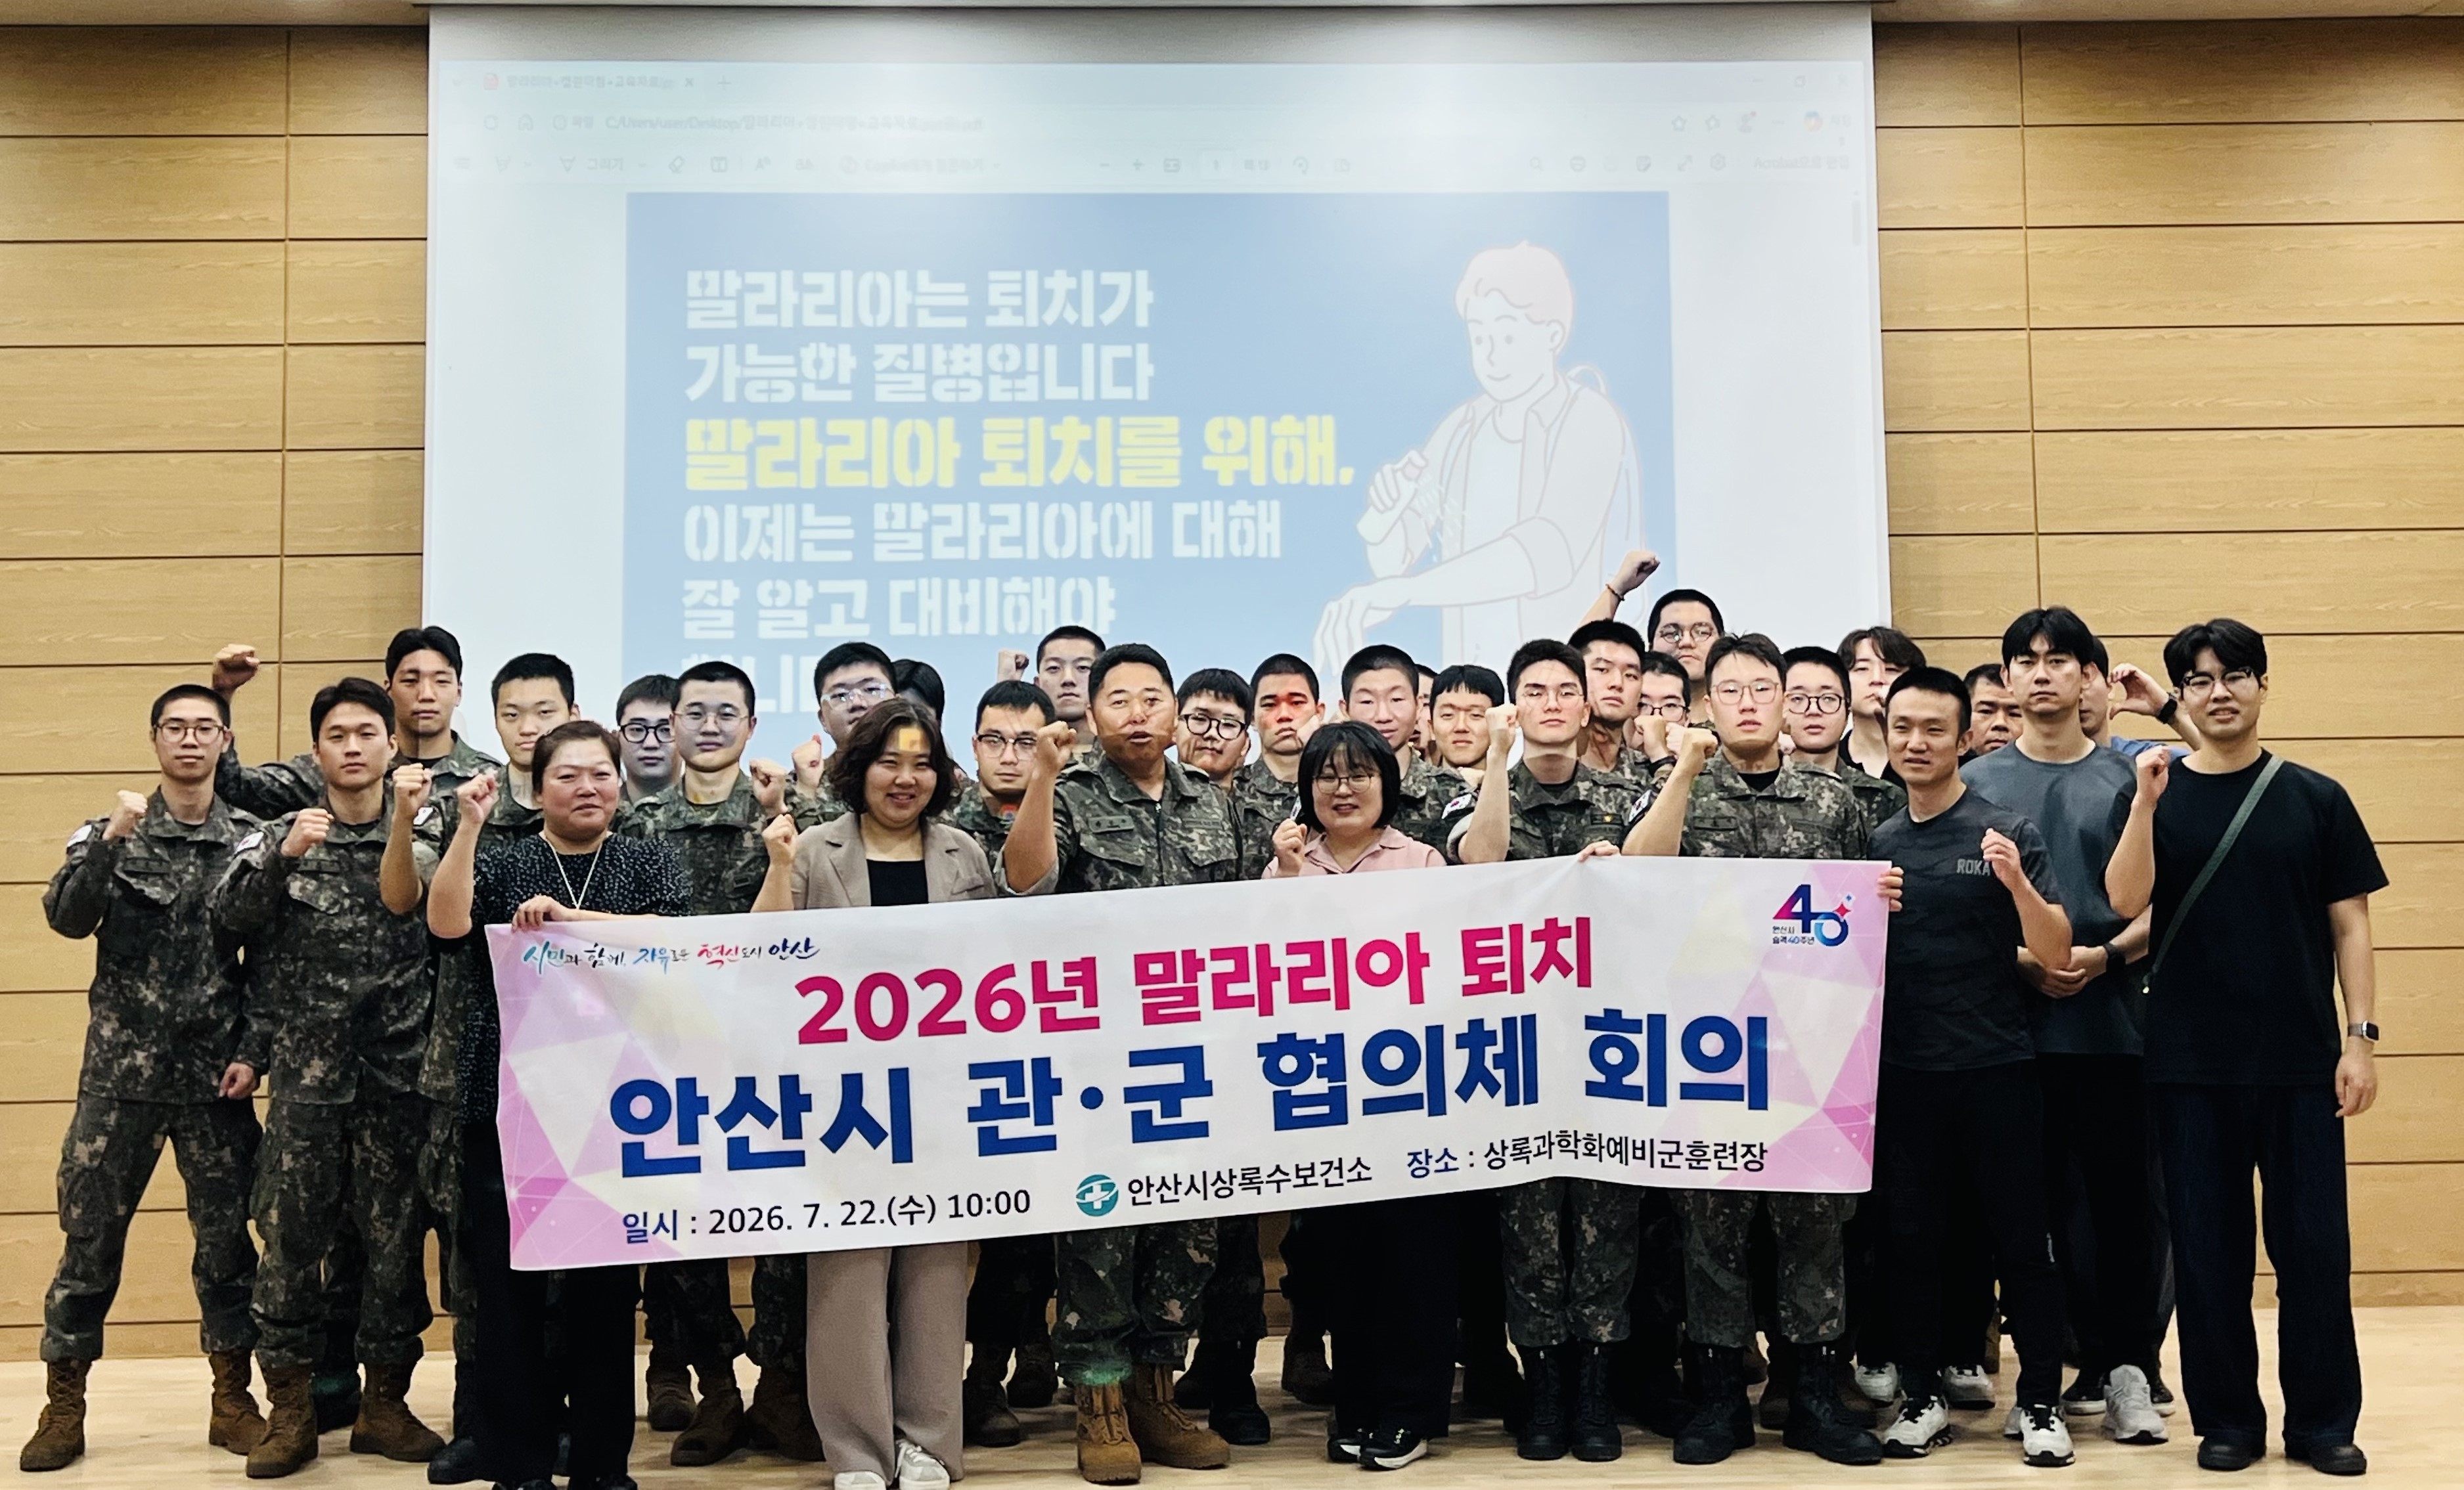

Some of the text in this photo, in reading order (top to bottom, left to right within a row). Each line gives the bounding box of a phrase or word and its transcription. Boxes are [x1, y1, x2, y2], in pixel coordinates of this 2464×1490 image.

[686, 269, 1154, 328] 말라리아는 퇴치가
[684, 341, 1154, 403] 가능한 질병입니다
[685, 414, 1355, 491] 말라리아 퇴치를 위해,
[683, 499, 1282, 564] 이제는 말라리아에 대해
[681, 575, 1117, 640] 잘 알고 대비해야
[1957, 858, 1990, 876] ROKA
[524, 941, 581, 975] 시민과
[633, 947, 690, 974] 자유로운
[697, 944, 761, 970] 혁신도시
[768, 937, 821, 960] 안산
[795, 917, 1592, 1044] 2026년 말라리아 퇴치
[610, 1009, 1768, 1179] 안산시 관·군 협의체 회의
[1127, 1156, 1373, 1206] 안산시상록수보건소
[1406, 1129, 1768, 1180] 장소 : 상록과학화예비군훈련장
[623, 1189, 1032, 1245] 일시 : 2026. 7. 22.(수) 10:00
